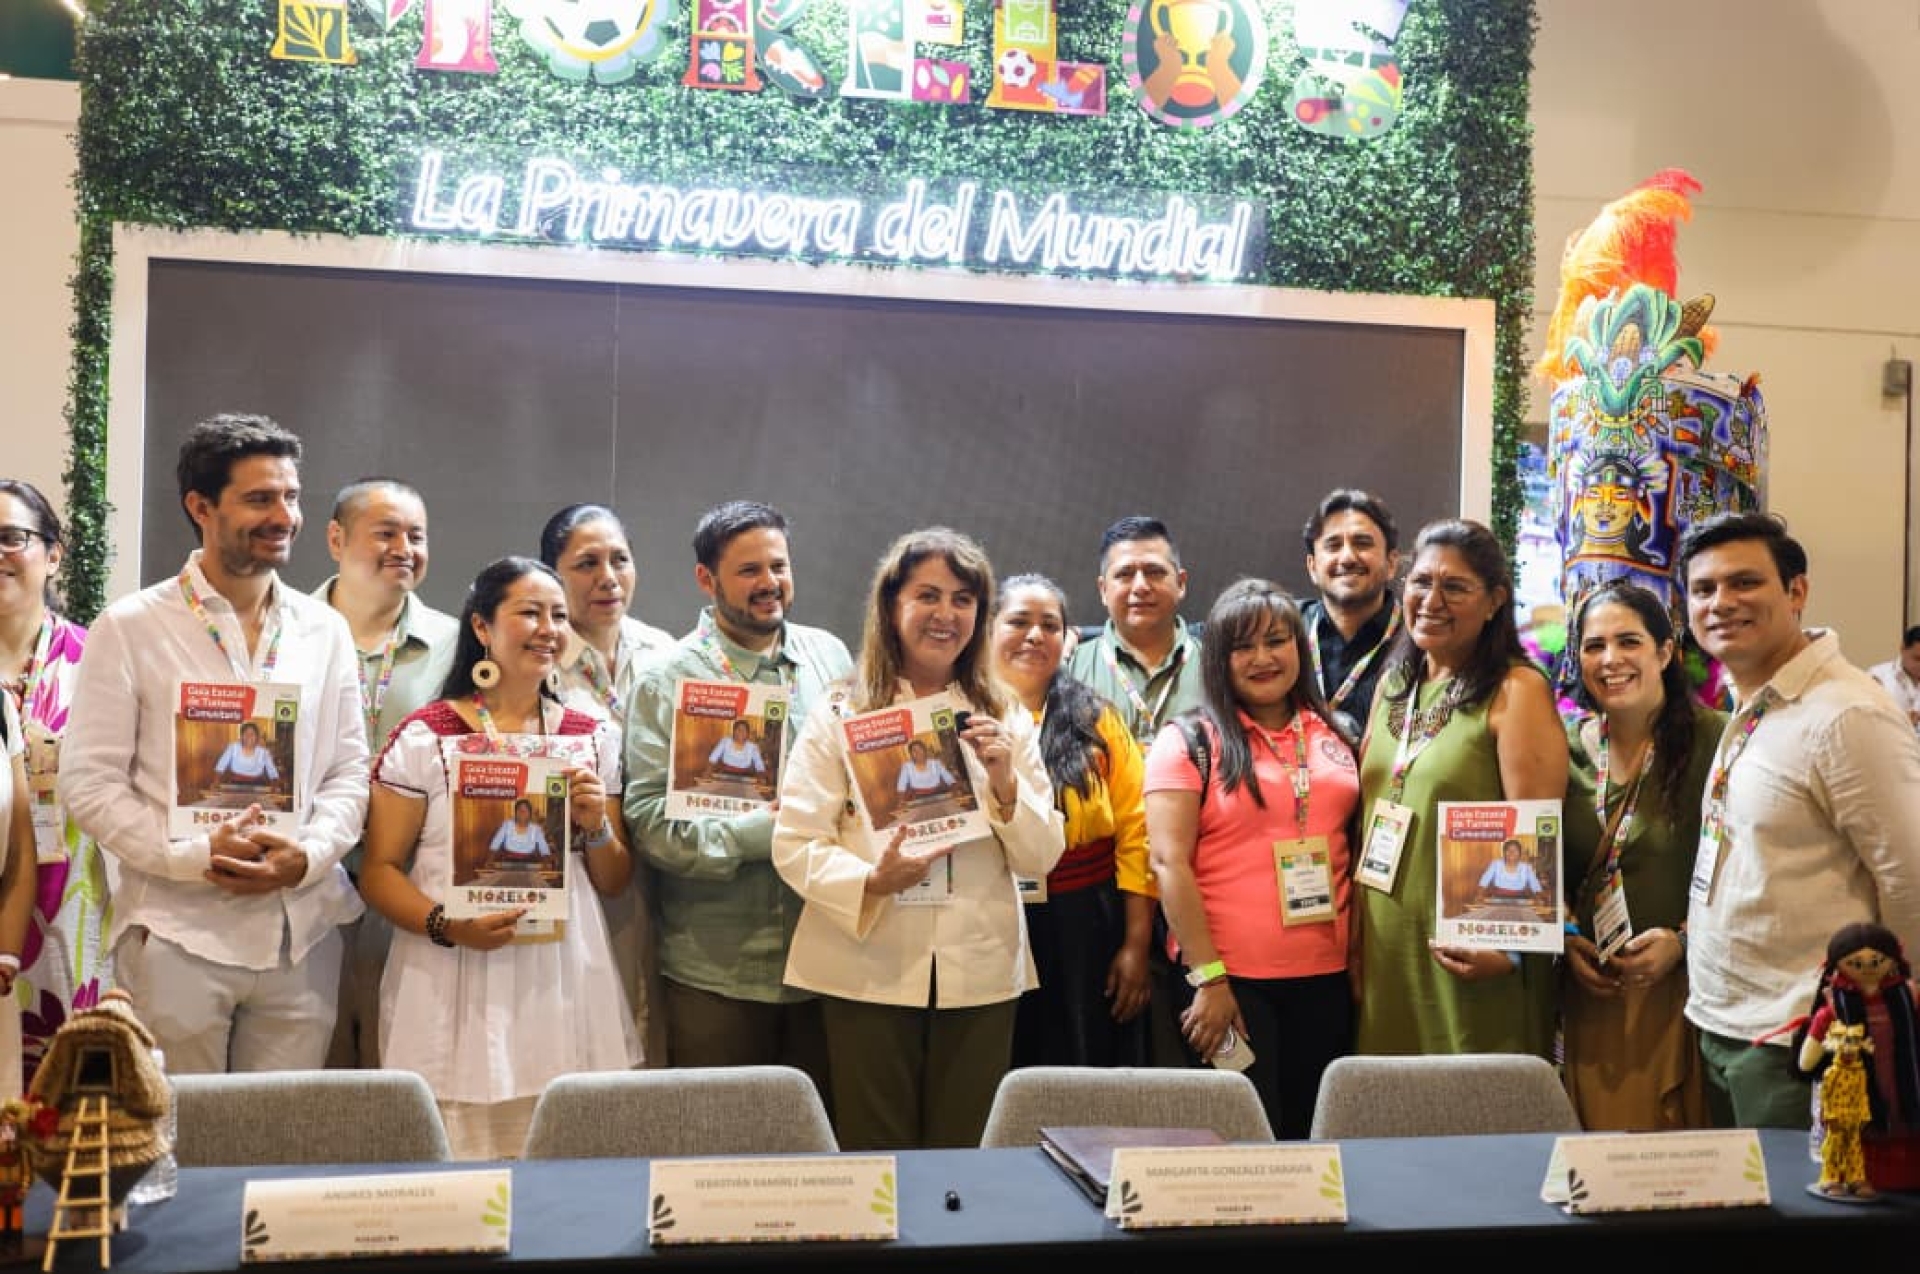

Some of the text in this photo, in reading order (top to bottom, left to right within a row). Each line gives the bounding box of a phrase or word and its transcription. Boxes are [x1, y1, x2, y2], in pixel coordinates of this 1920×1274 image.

[412, 152, 1252, 278] La Primavera del Mundial
[892, 817, 968, 839] ORELOS
[468, 889, 547, 903] MORELOS
[1457, 923, 1540, 935] MORELOS
[1146, 1166, 1210, 1177] MARGARITA
[376, 1187, 435, 1199] MORALES
